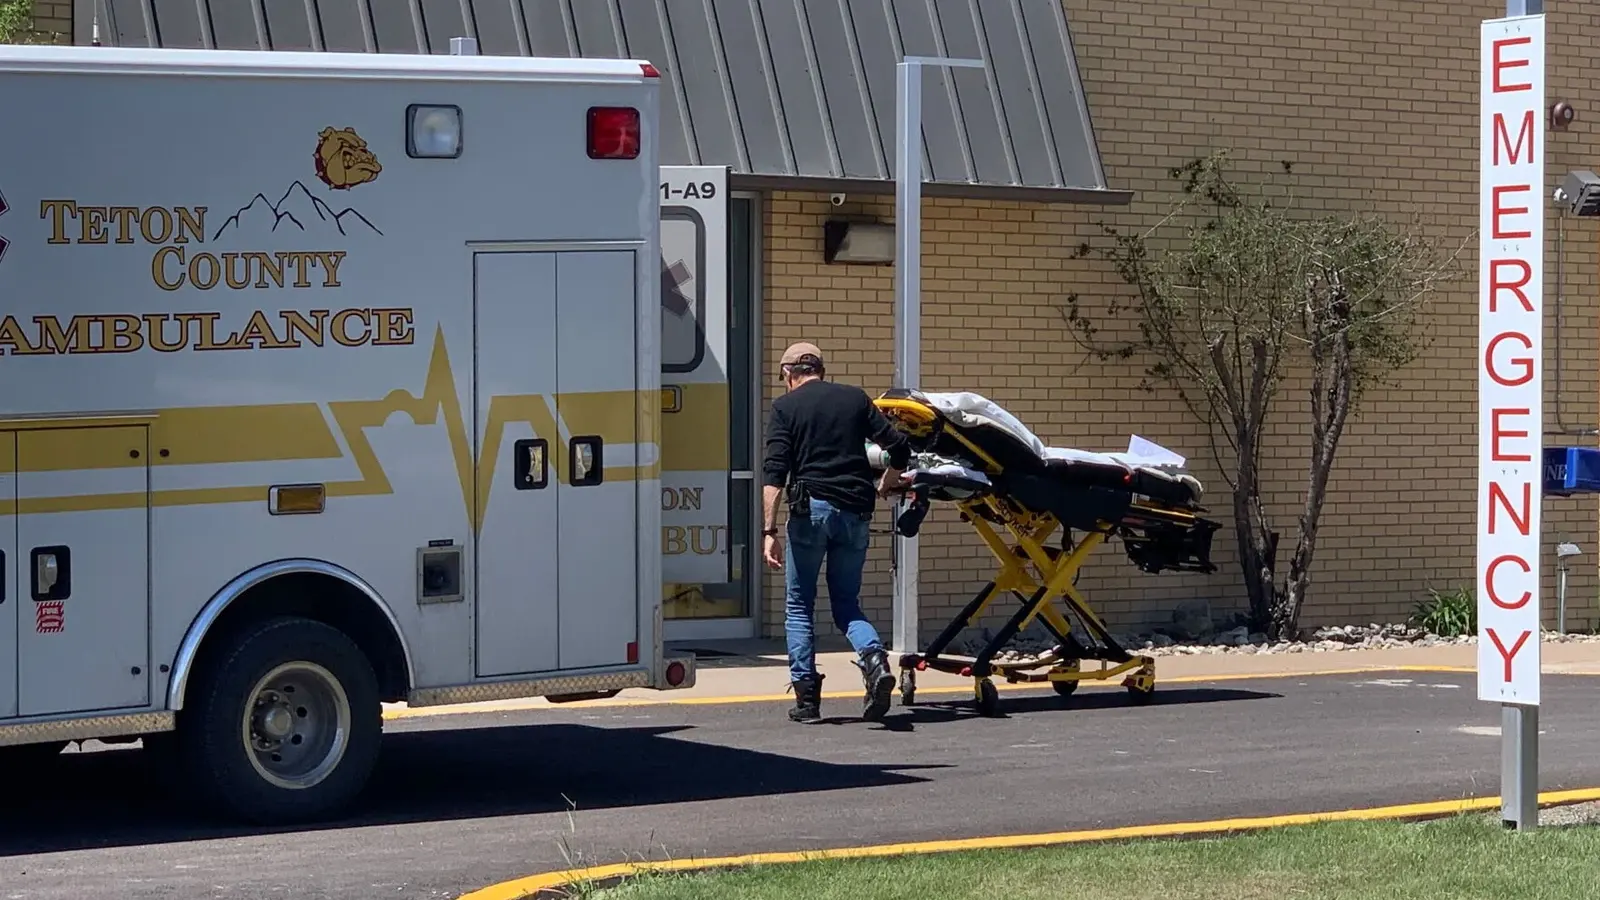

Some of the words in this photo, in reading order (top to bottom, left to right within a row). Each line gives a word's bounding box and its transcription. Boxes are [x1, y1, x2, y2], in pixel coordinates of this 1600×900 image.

[40, 200, 208, 244] TETON
[152, 246, 347, 290] COUNTY
[0, 308, 415, 355] AMBULANCE
[1486, 38, 1533, 680] EMERGENCY
